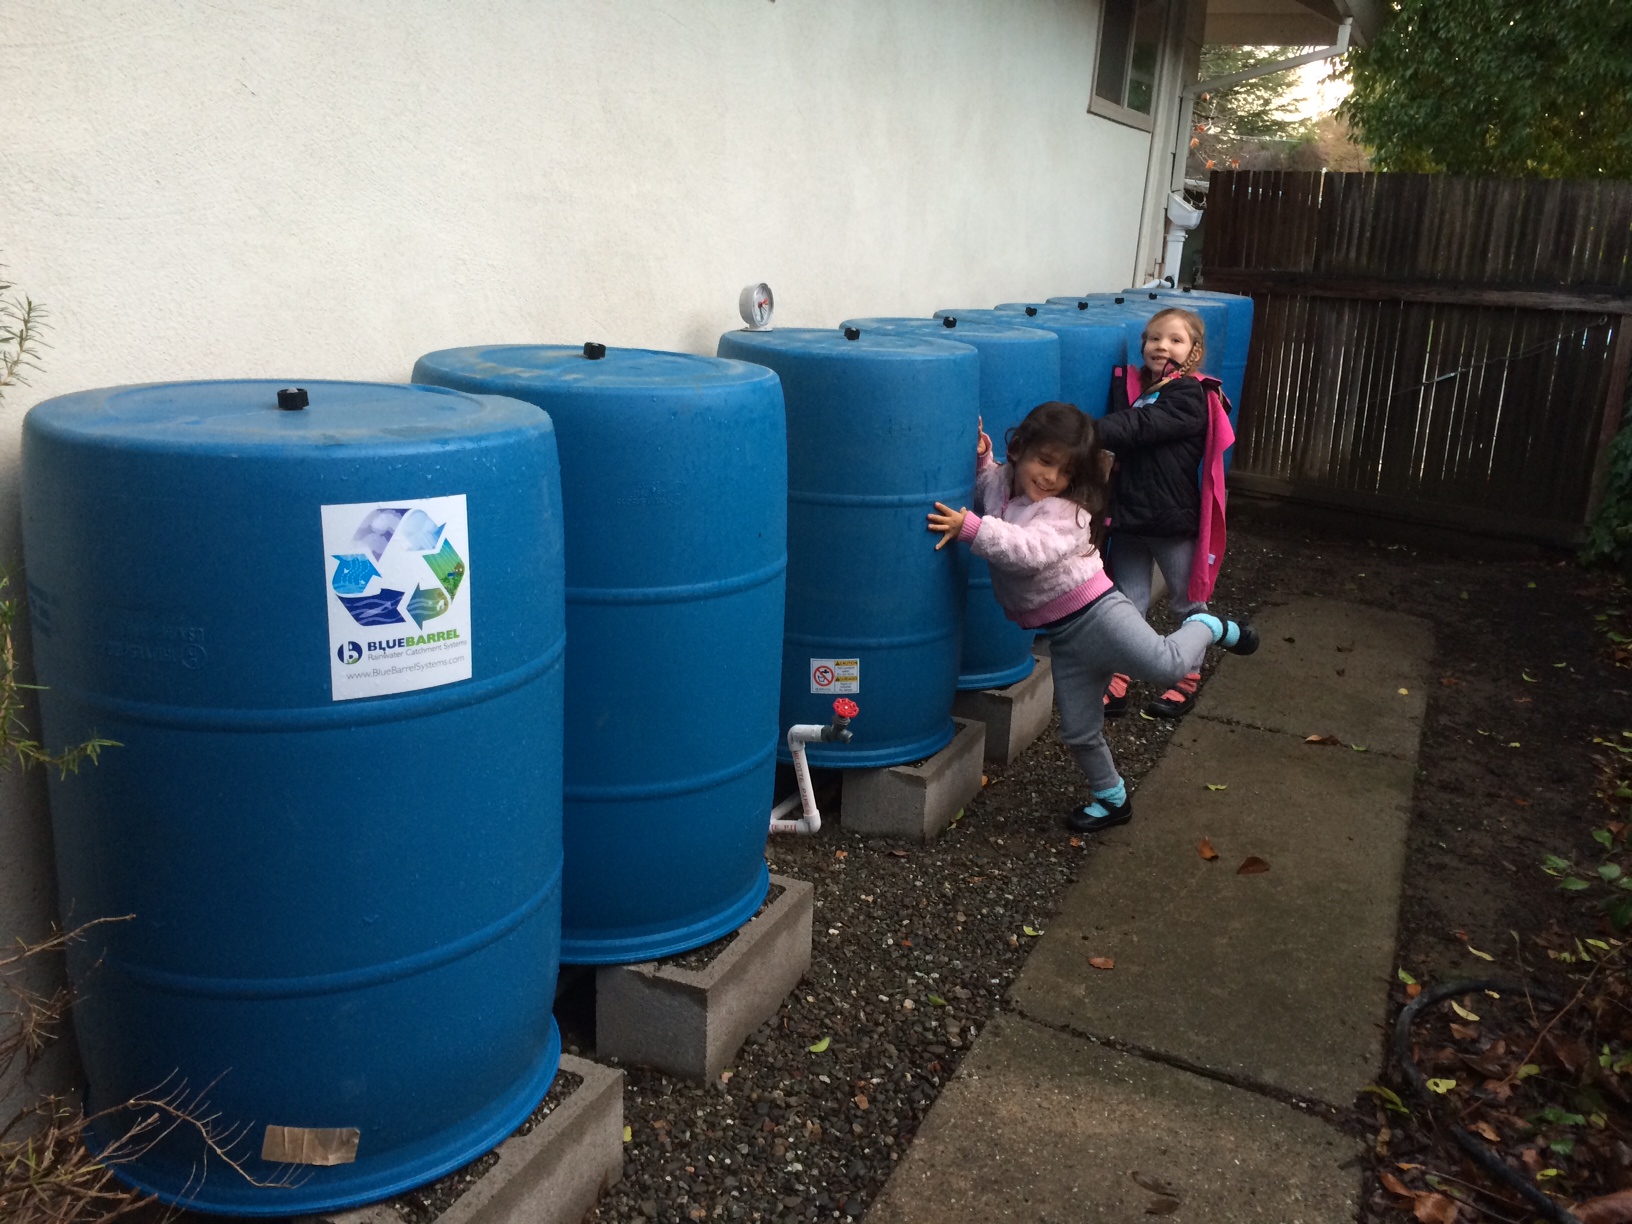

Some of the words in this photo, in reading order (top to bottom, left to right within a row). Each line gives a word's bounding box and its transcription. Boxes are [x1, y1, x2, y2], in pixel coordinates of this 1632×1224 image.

[367, 629, 460, 652] BLUEBARREL
[367, 651, 404, 661] Rainwater
[405, 644, 442, 656] Catchment
[443, 640, 468, 651] Systems
[346, 655, 465, 680] www.BlueBarrelSystems.com
